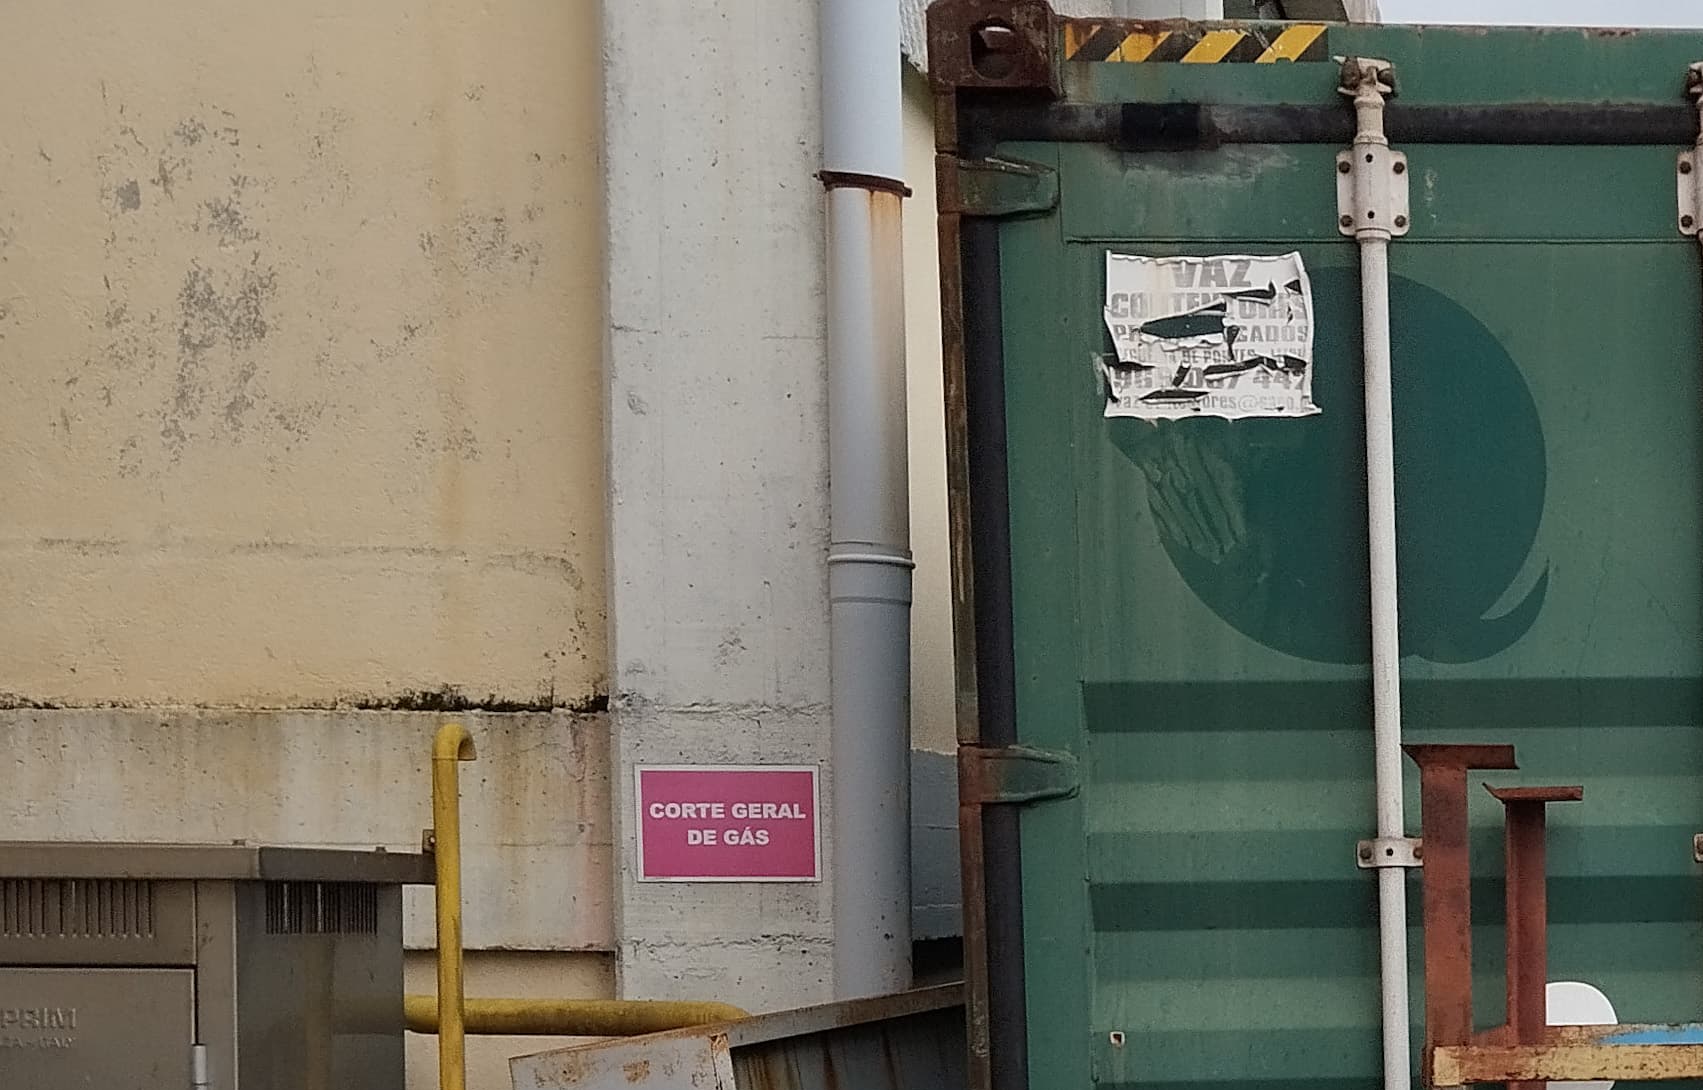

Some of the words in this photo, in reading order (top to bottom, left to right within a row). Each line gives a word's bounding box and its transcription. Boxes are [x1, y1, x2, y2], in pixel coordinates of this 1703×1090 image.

[1173, 260, 1251, 288] VAZ
[650, 802, 725, 819] CORTE
[731, 803, 806, 819] GERAL
[687, 829, 717, 845] DE
[723, 826, 770, 846] GÁS
